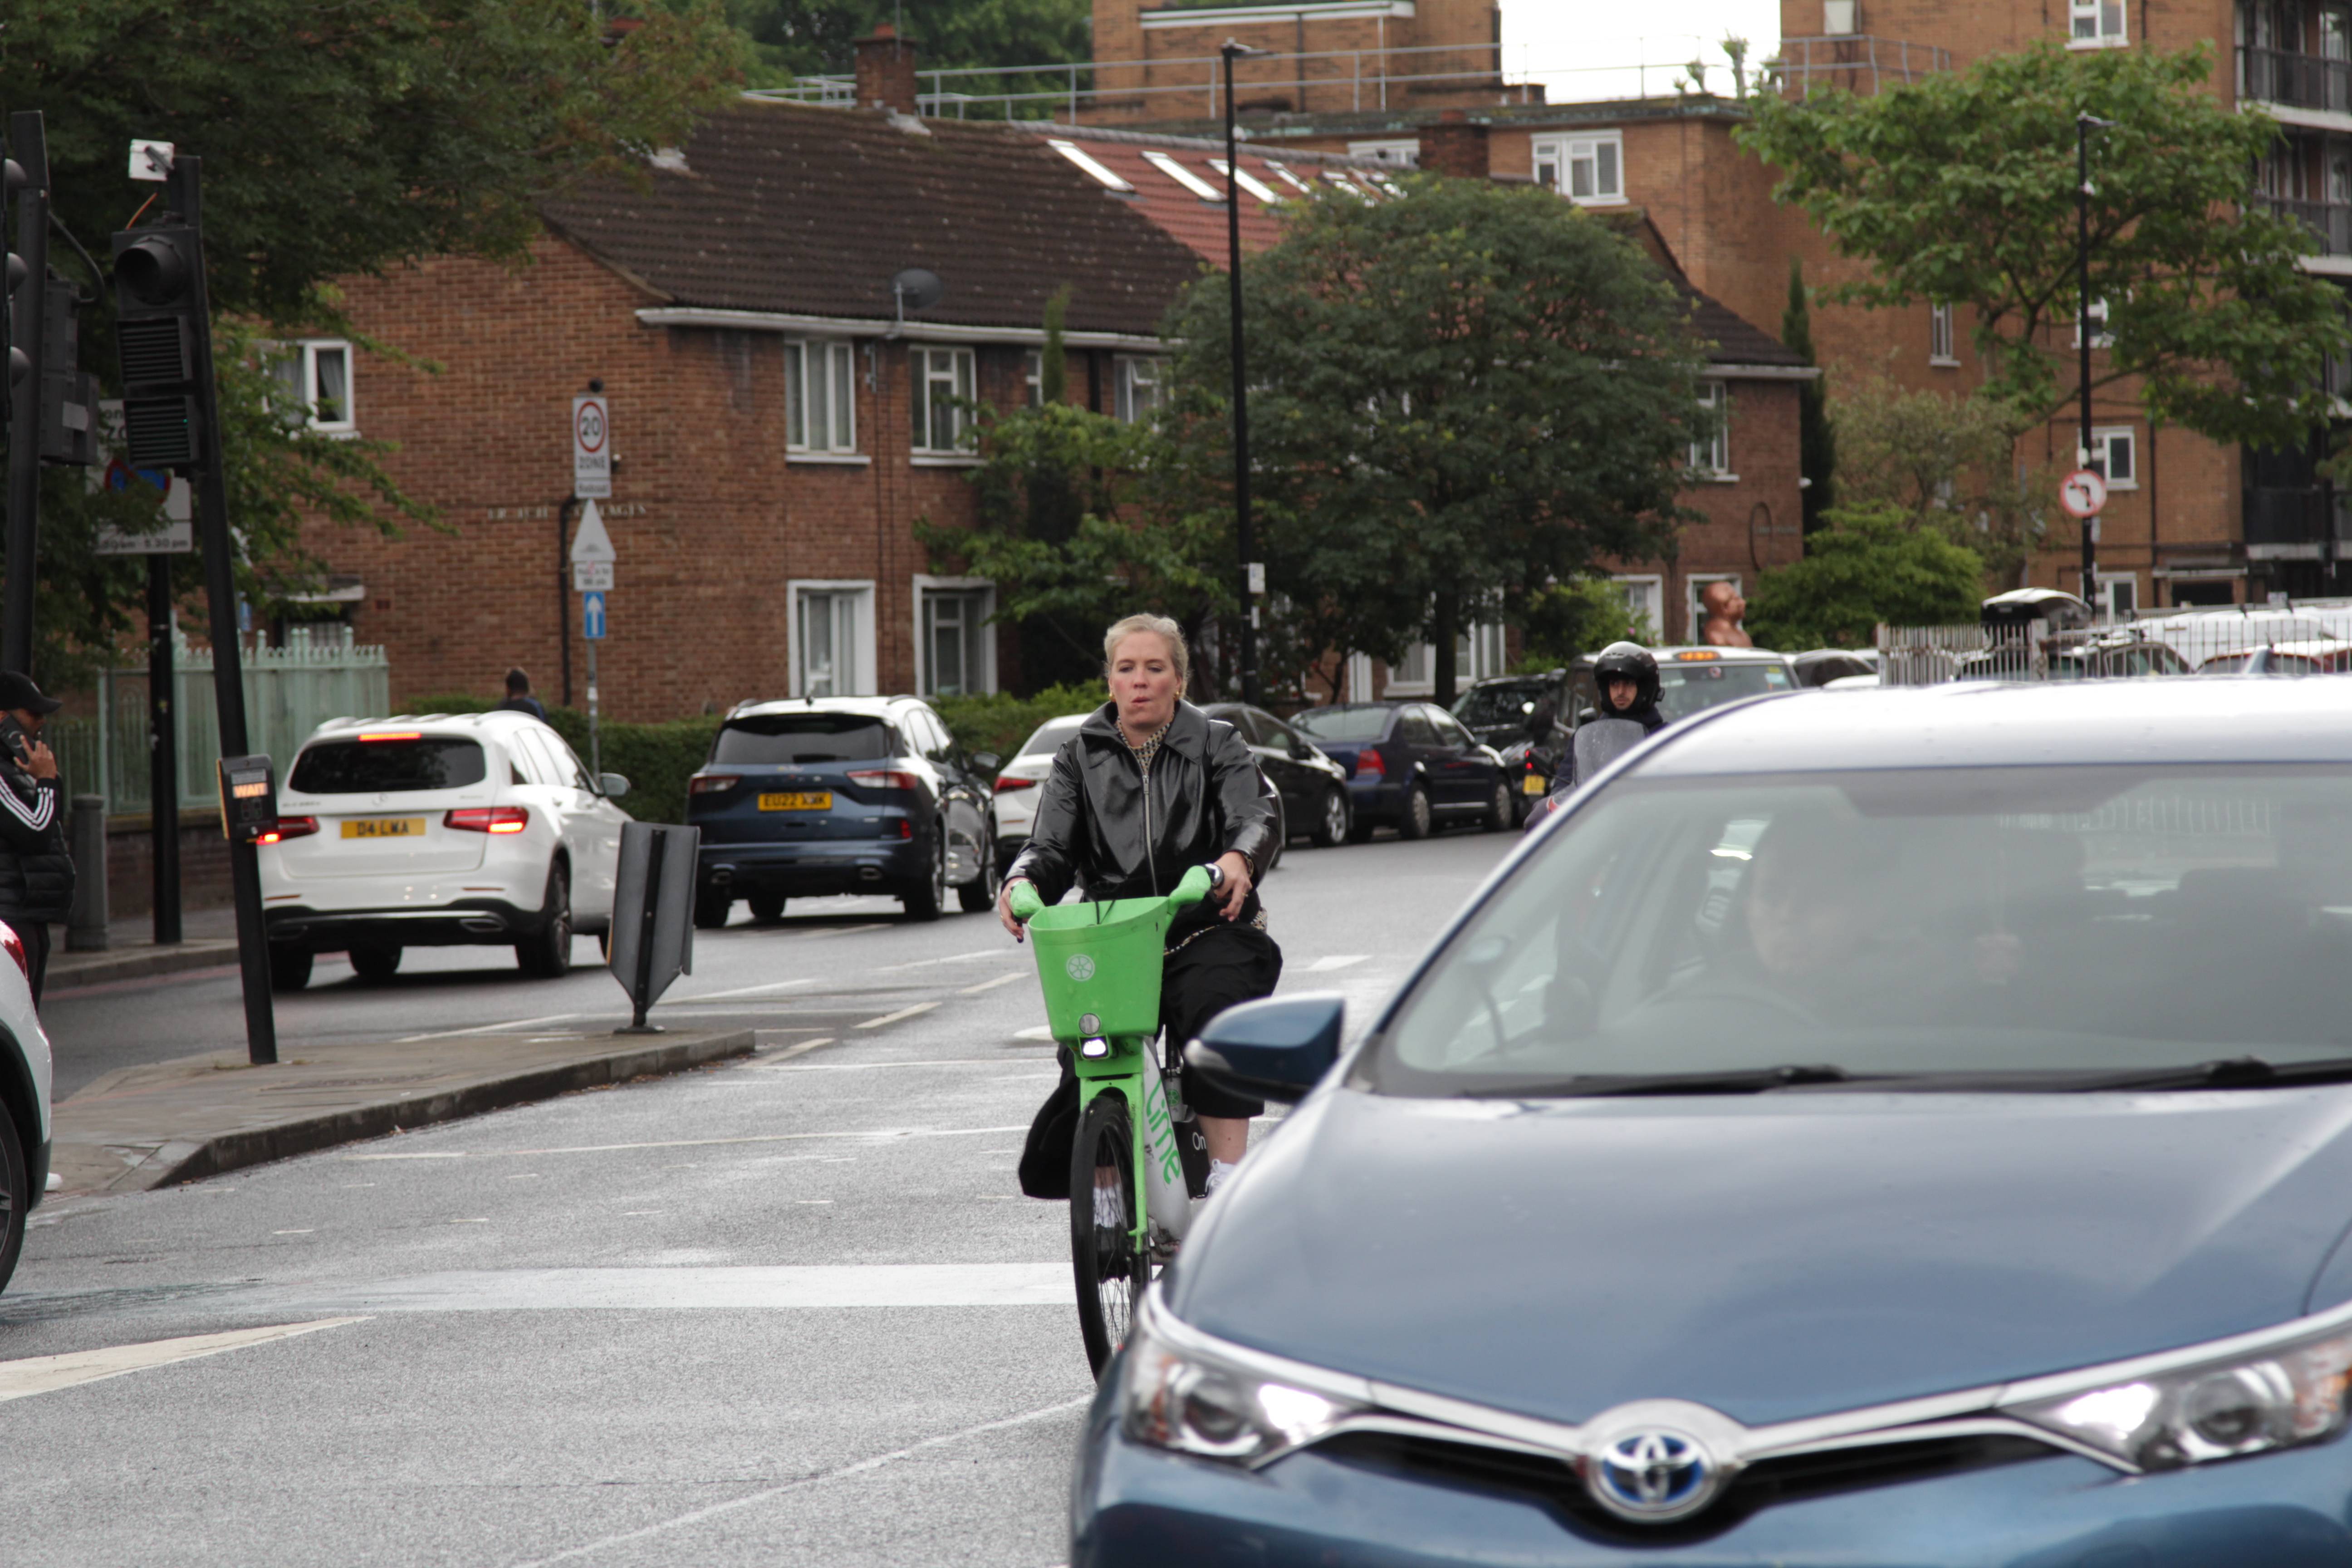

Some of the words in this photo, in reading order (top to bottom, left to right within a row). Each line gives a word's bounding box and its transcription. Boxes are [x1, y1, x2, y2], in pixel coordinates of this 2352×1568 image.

[582, 416, 601, 436] 20
[579, 456, 605, 470] ZONE
[234, 783, 267, 798] WAIT
[764, 793, 797, 806] EU22
[357, 822, 375, 836] D4
